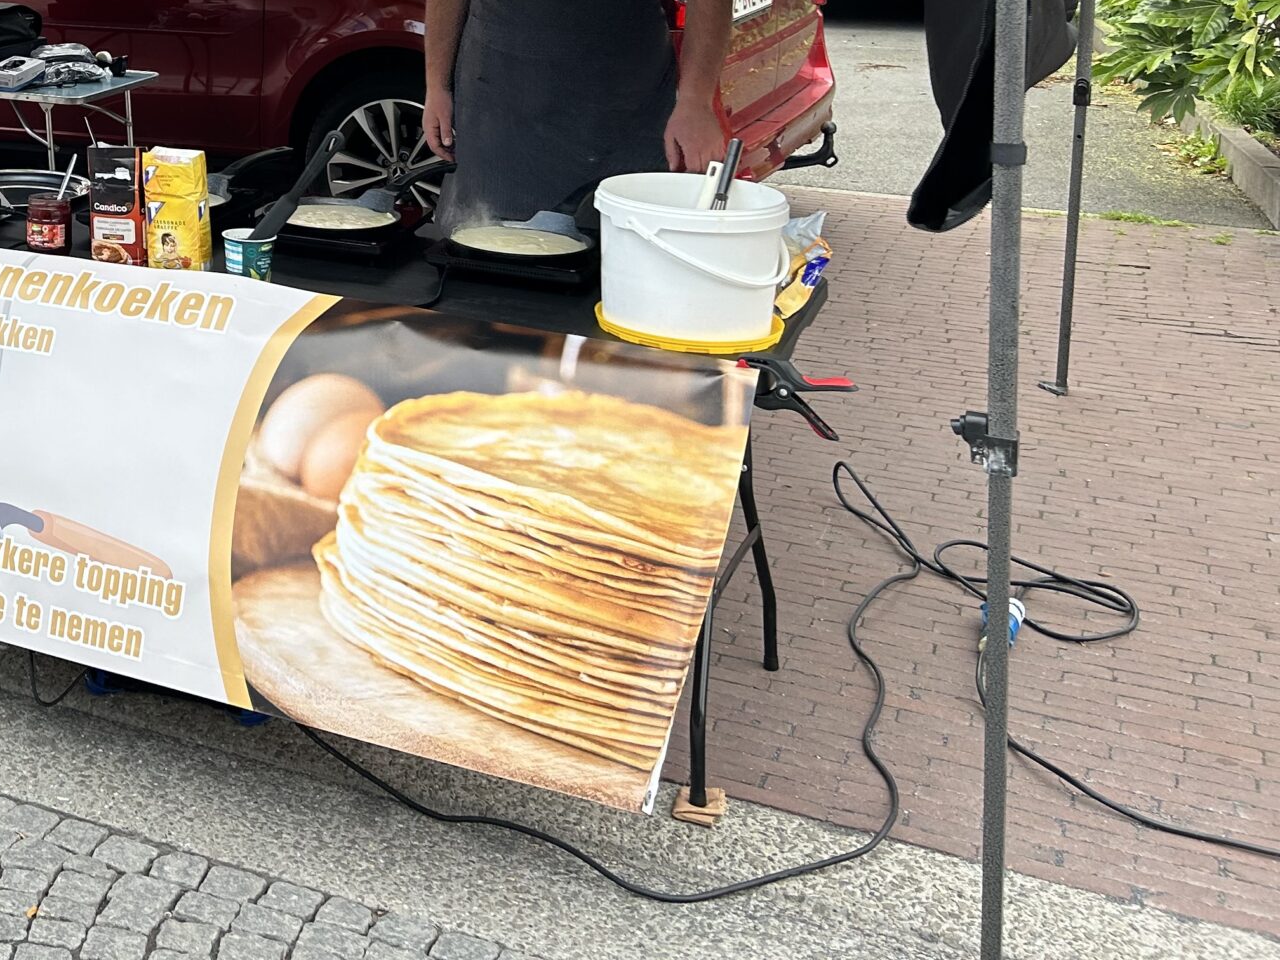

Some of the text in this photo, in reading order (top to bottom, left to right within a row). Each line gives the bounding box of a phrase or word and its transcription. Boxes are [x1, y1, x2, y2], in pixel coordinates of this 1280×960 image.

[93, 202, 128, 213] Candico
[75, 556, 184, 616] topping
[15, 594, 42, 629] te
[50, 607, 144, 658] nemen
